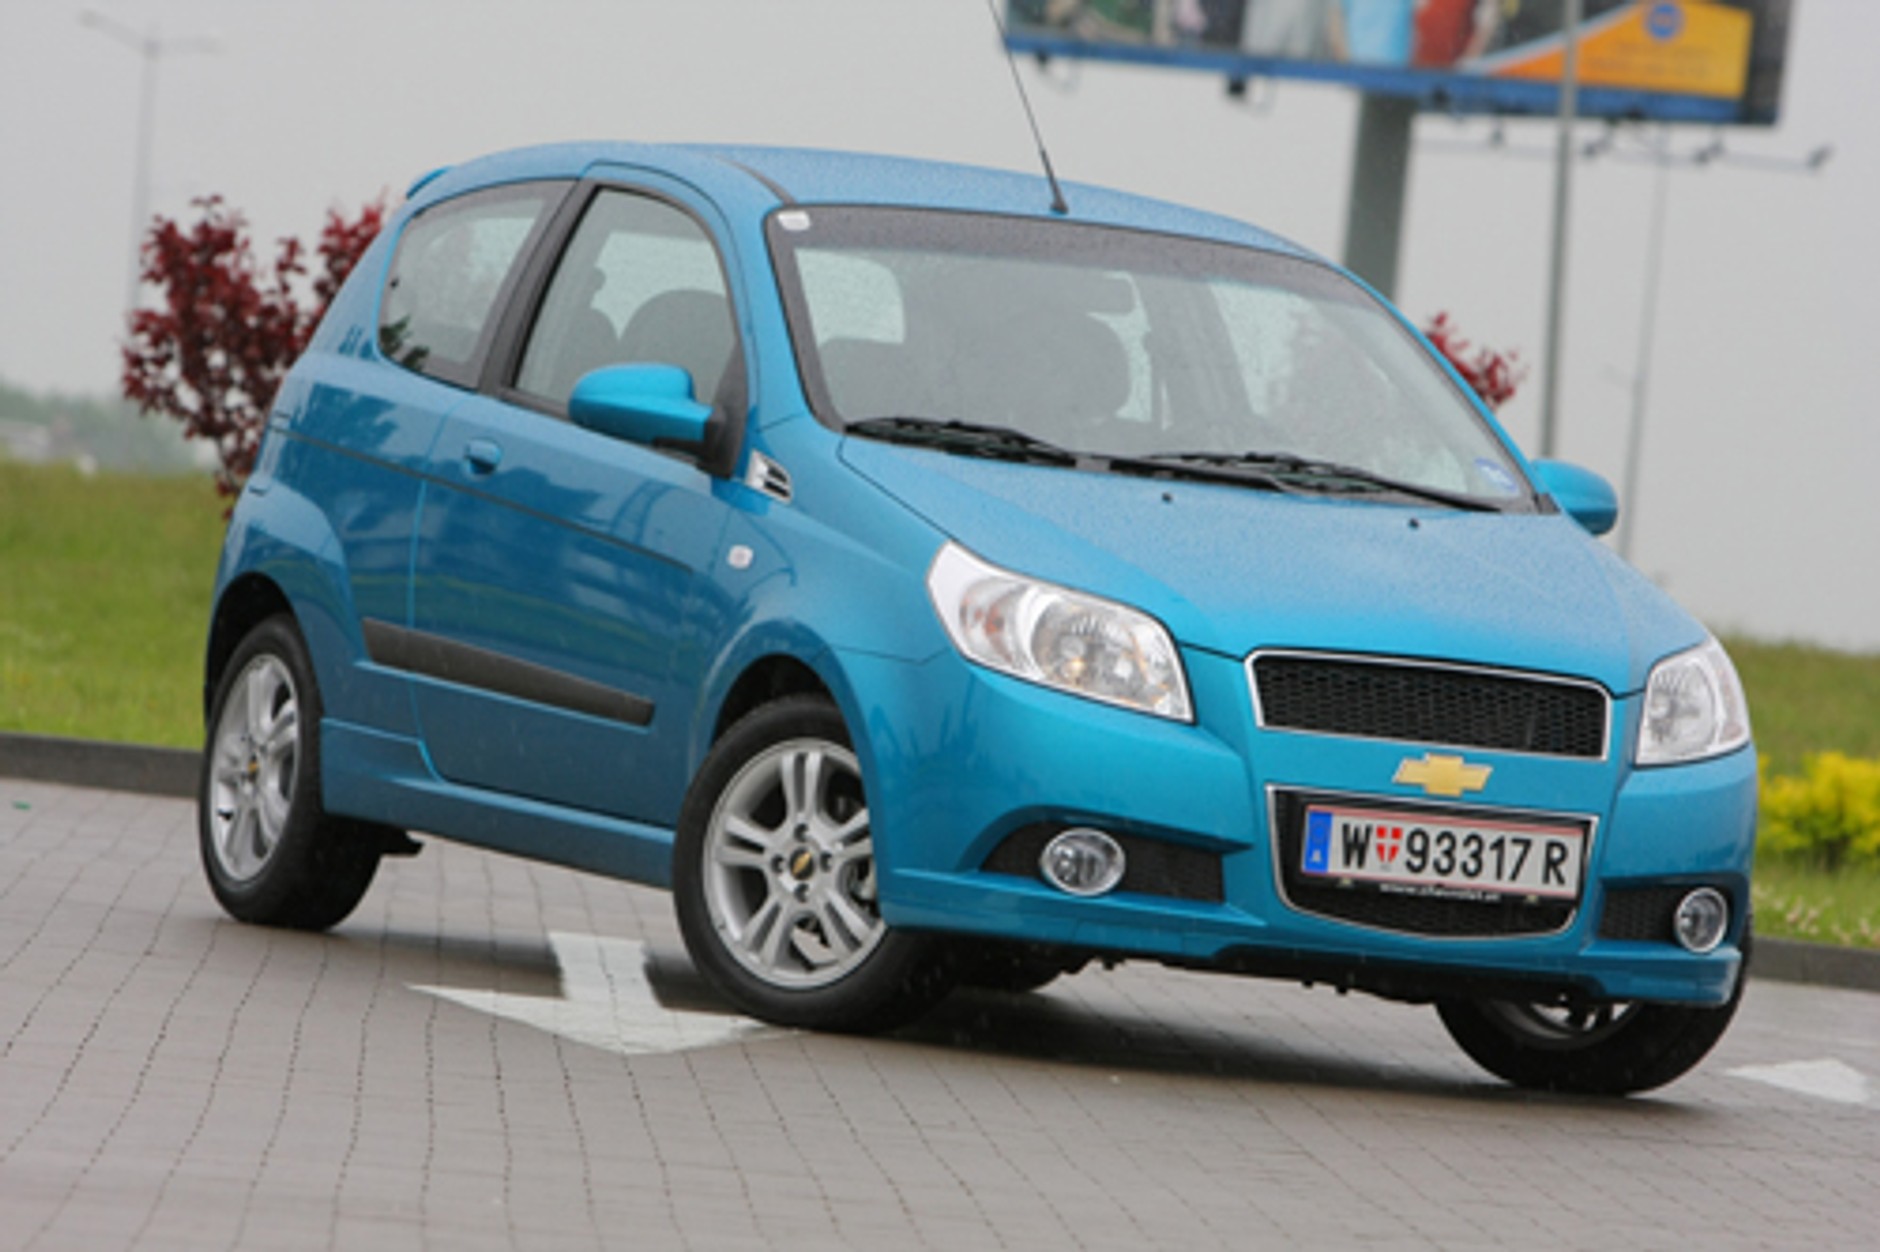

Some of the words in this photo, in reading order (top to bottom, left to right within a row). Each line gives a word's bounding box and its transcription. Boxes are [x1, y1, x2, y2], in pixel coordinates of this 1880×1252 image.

[1342, 823, 1373, 869] W
[1405, 827, 1532, 882] 93317
[1542, 841, 1568, 886] R
